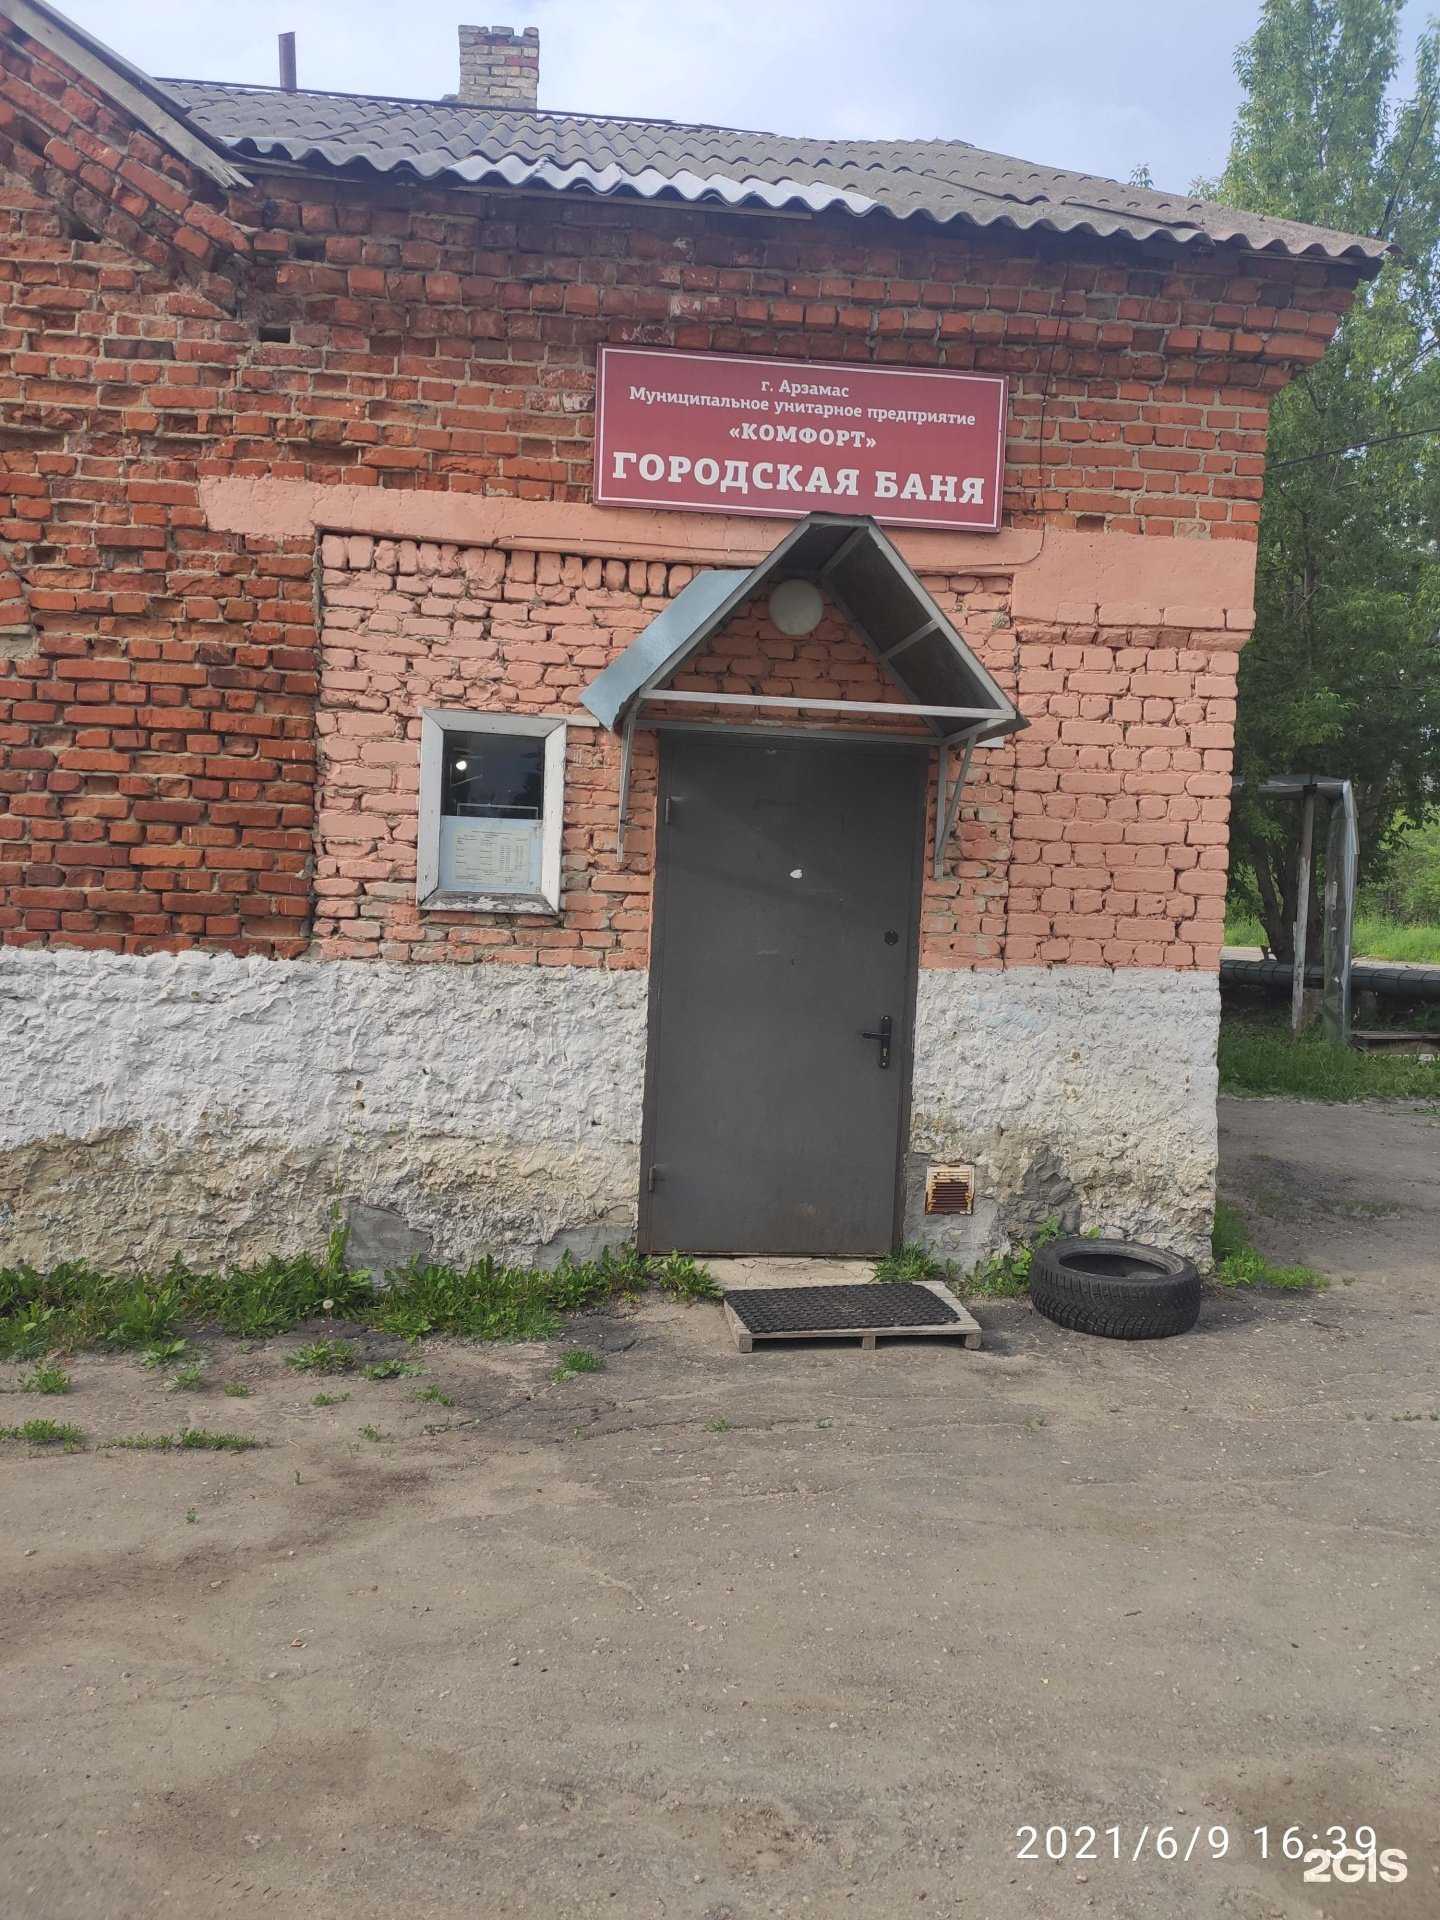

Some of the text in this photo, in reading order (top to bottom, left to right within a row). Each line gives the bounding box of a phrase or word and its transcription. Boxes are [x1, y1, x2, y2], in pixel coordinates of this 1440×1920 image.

[760, 379, 850, 398] г. Арзамас
[629, 386, 976, 426] Муниципальное унитарное предприятие
[729, 422, 877, 449] «КОМФОРТ»
[612, 450, 985, 505] ГОРОДСКАЯ БАНЯ
